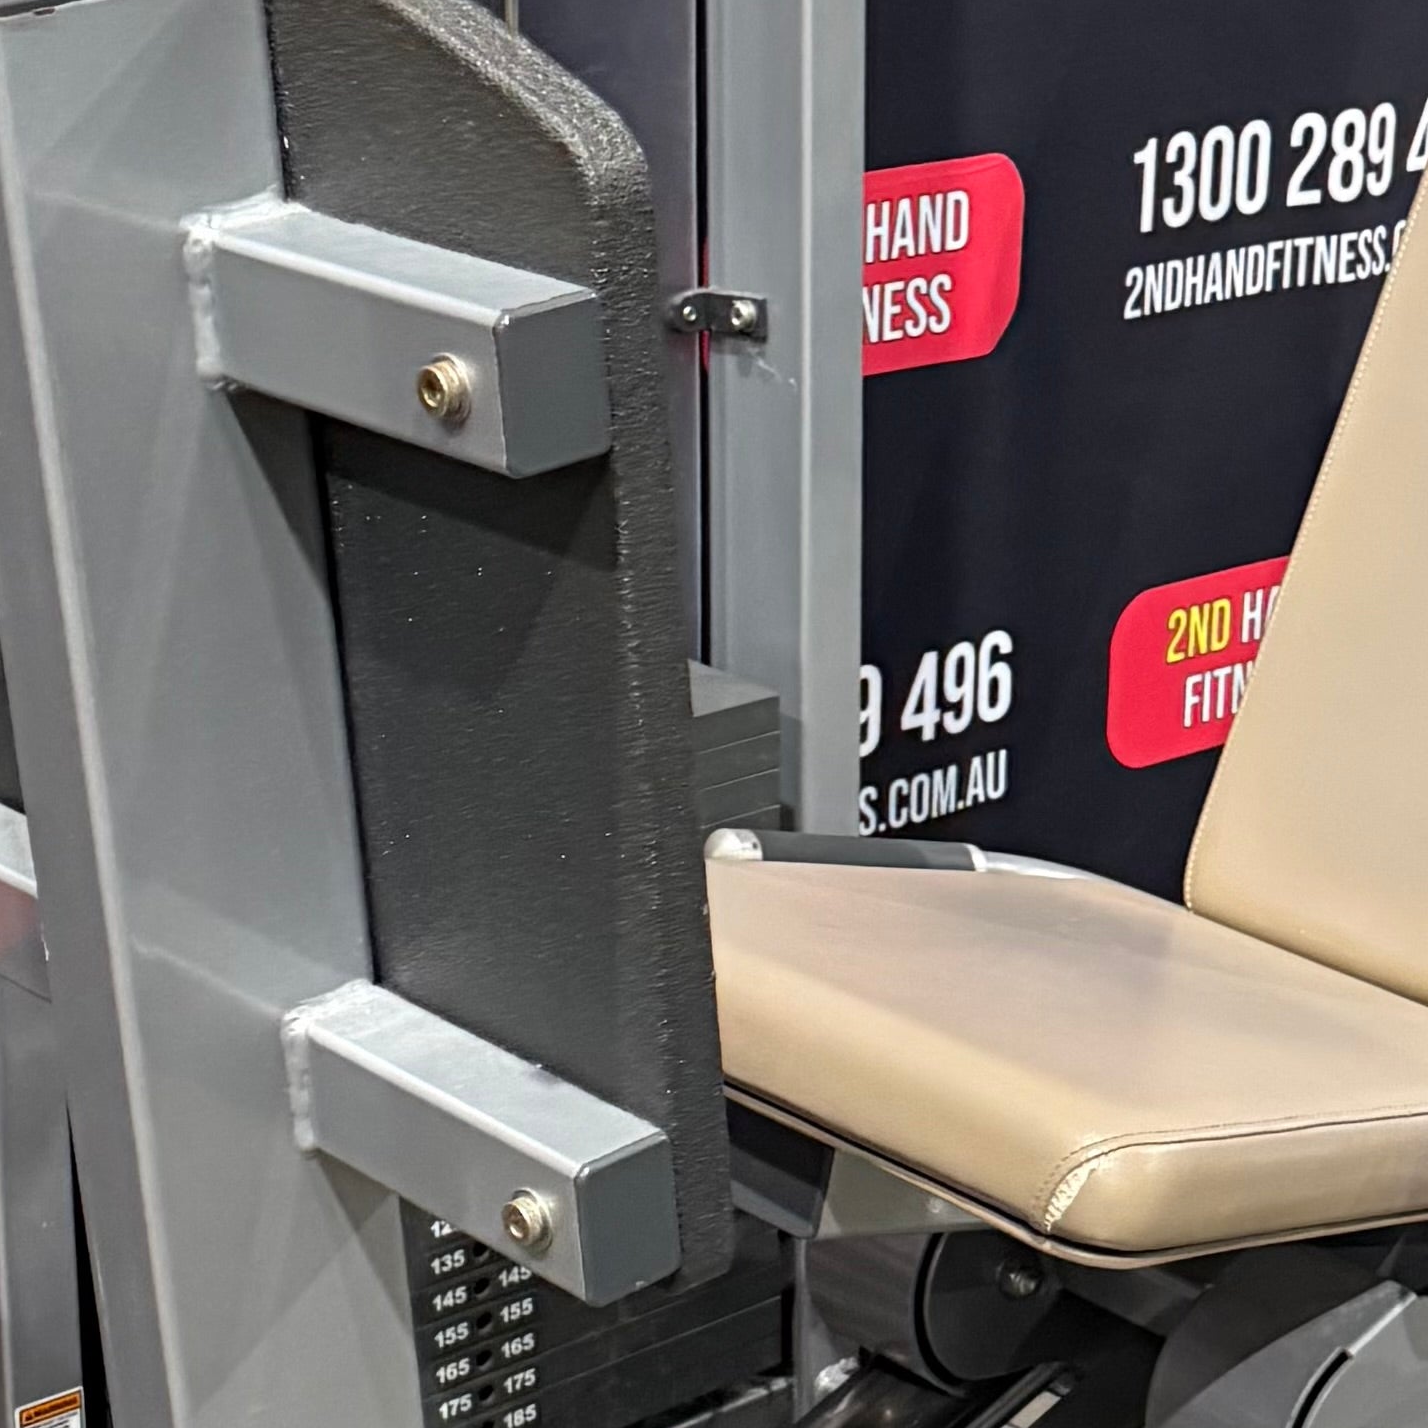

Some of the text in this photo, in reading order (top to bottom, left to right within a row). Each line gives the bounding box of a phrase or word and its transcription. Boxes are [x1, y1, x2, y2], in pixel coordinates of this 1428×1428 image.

[1133, 119, 1272, 233] 1300
[1285, 101, 1397, 207] 289
[865, 189, 970, 264] HAND
[1166, 597, 1232, 664] 2ND
[900, 629, 1013, 742] 496
[431, 1249, 465, 1275] 135
[432, 1285, 467, 1312] 145
[500, 1297, 533, 1323] 155
[434, 1322, 469, 1349] 155
[501, 1332, 536, 1359] 165
[436, 1357, 470, 1384] 165
[503, 1368, 536, 1394] 175
[438, 1393, 472, 1420] 175
